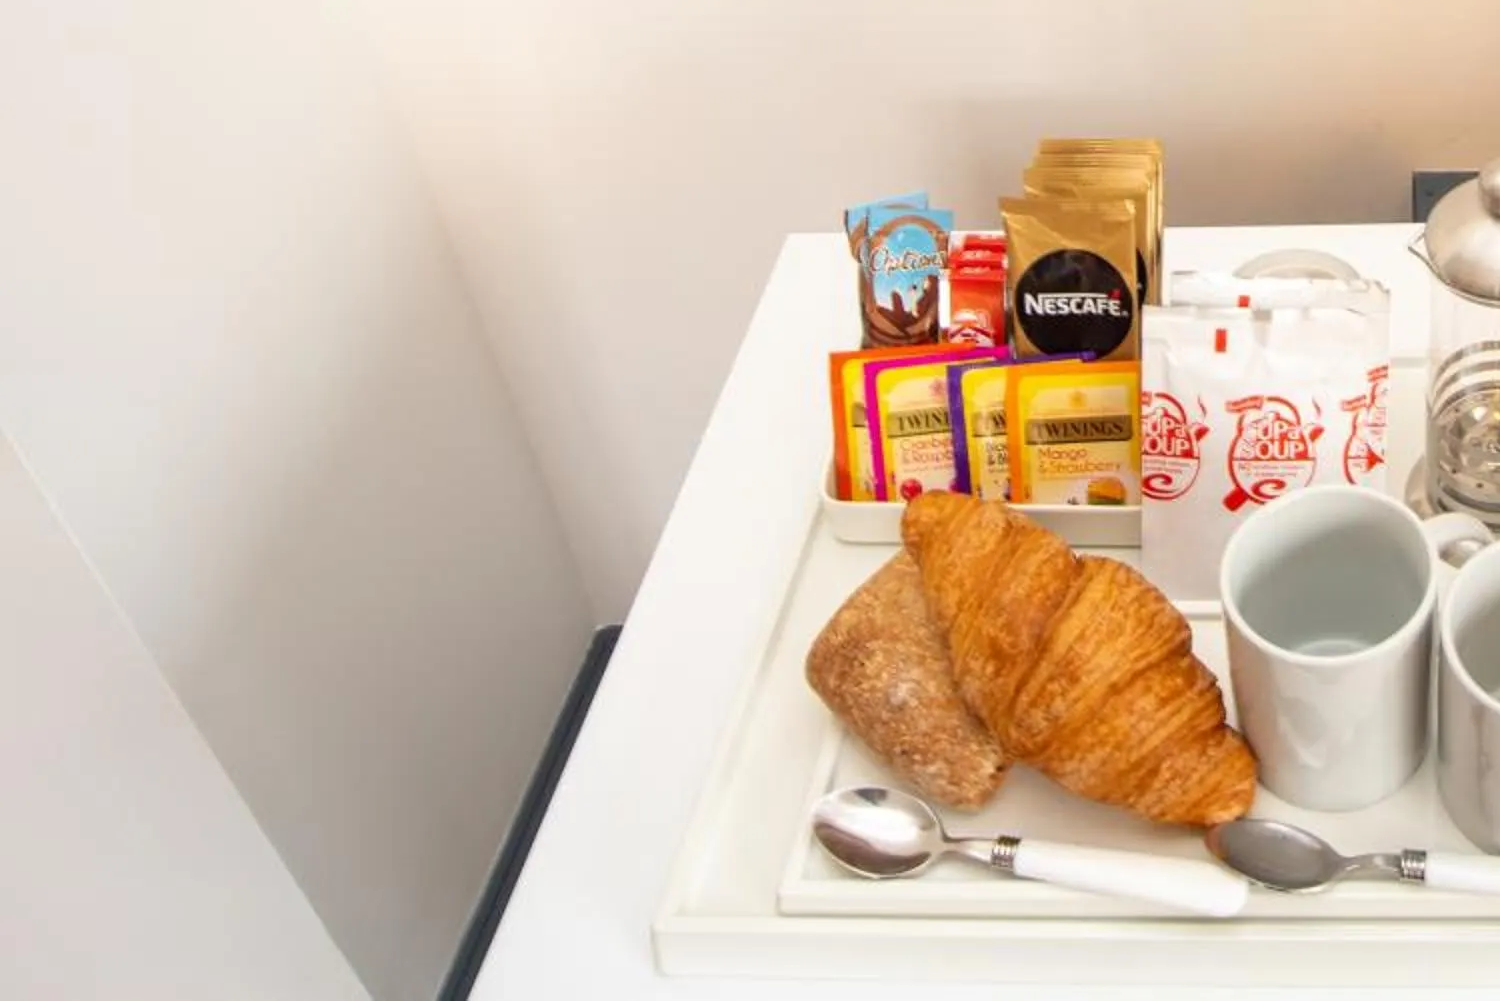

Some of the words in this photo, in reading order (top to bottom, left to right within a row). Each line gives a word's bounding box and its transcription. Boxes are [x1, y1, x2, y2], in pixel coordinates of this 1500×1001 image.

[1031, 421, 1124, 439] TWININGS
[1039, 447, 1087, 460] Mango
[1141, 436, 1190, 456] OUP
[1239, 439, 1304, 459] SOUP
